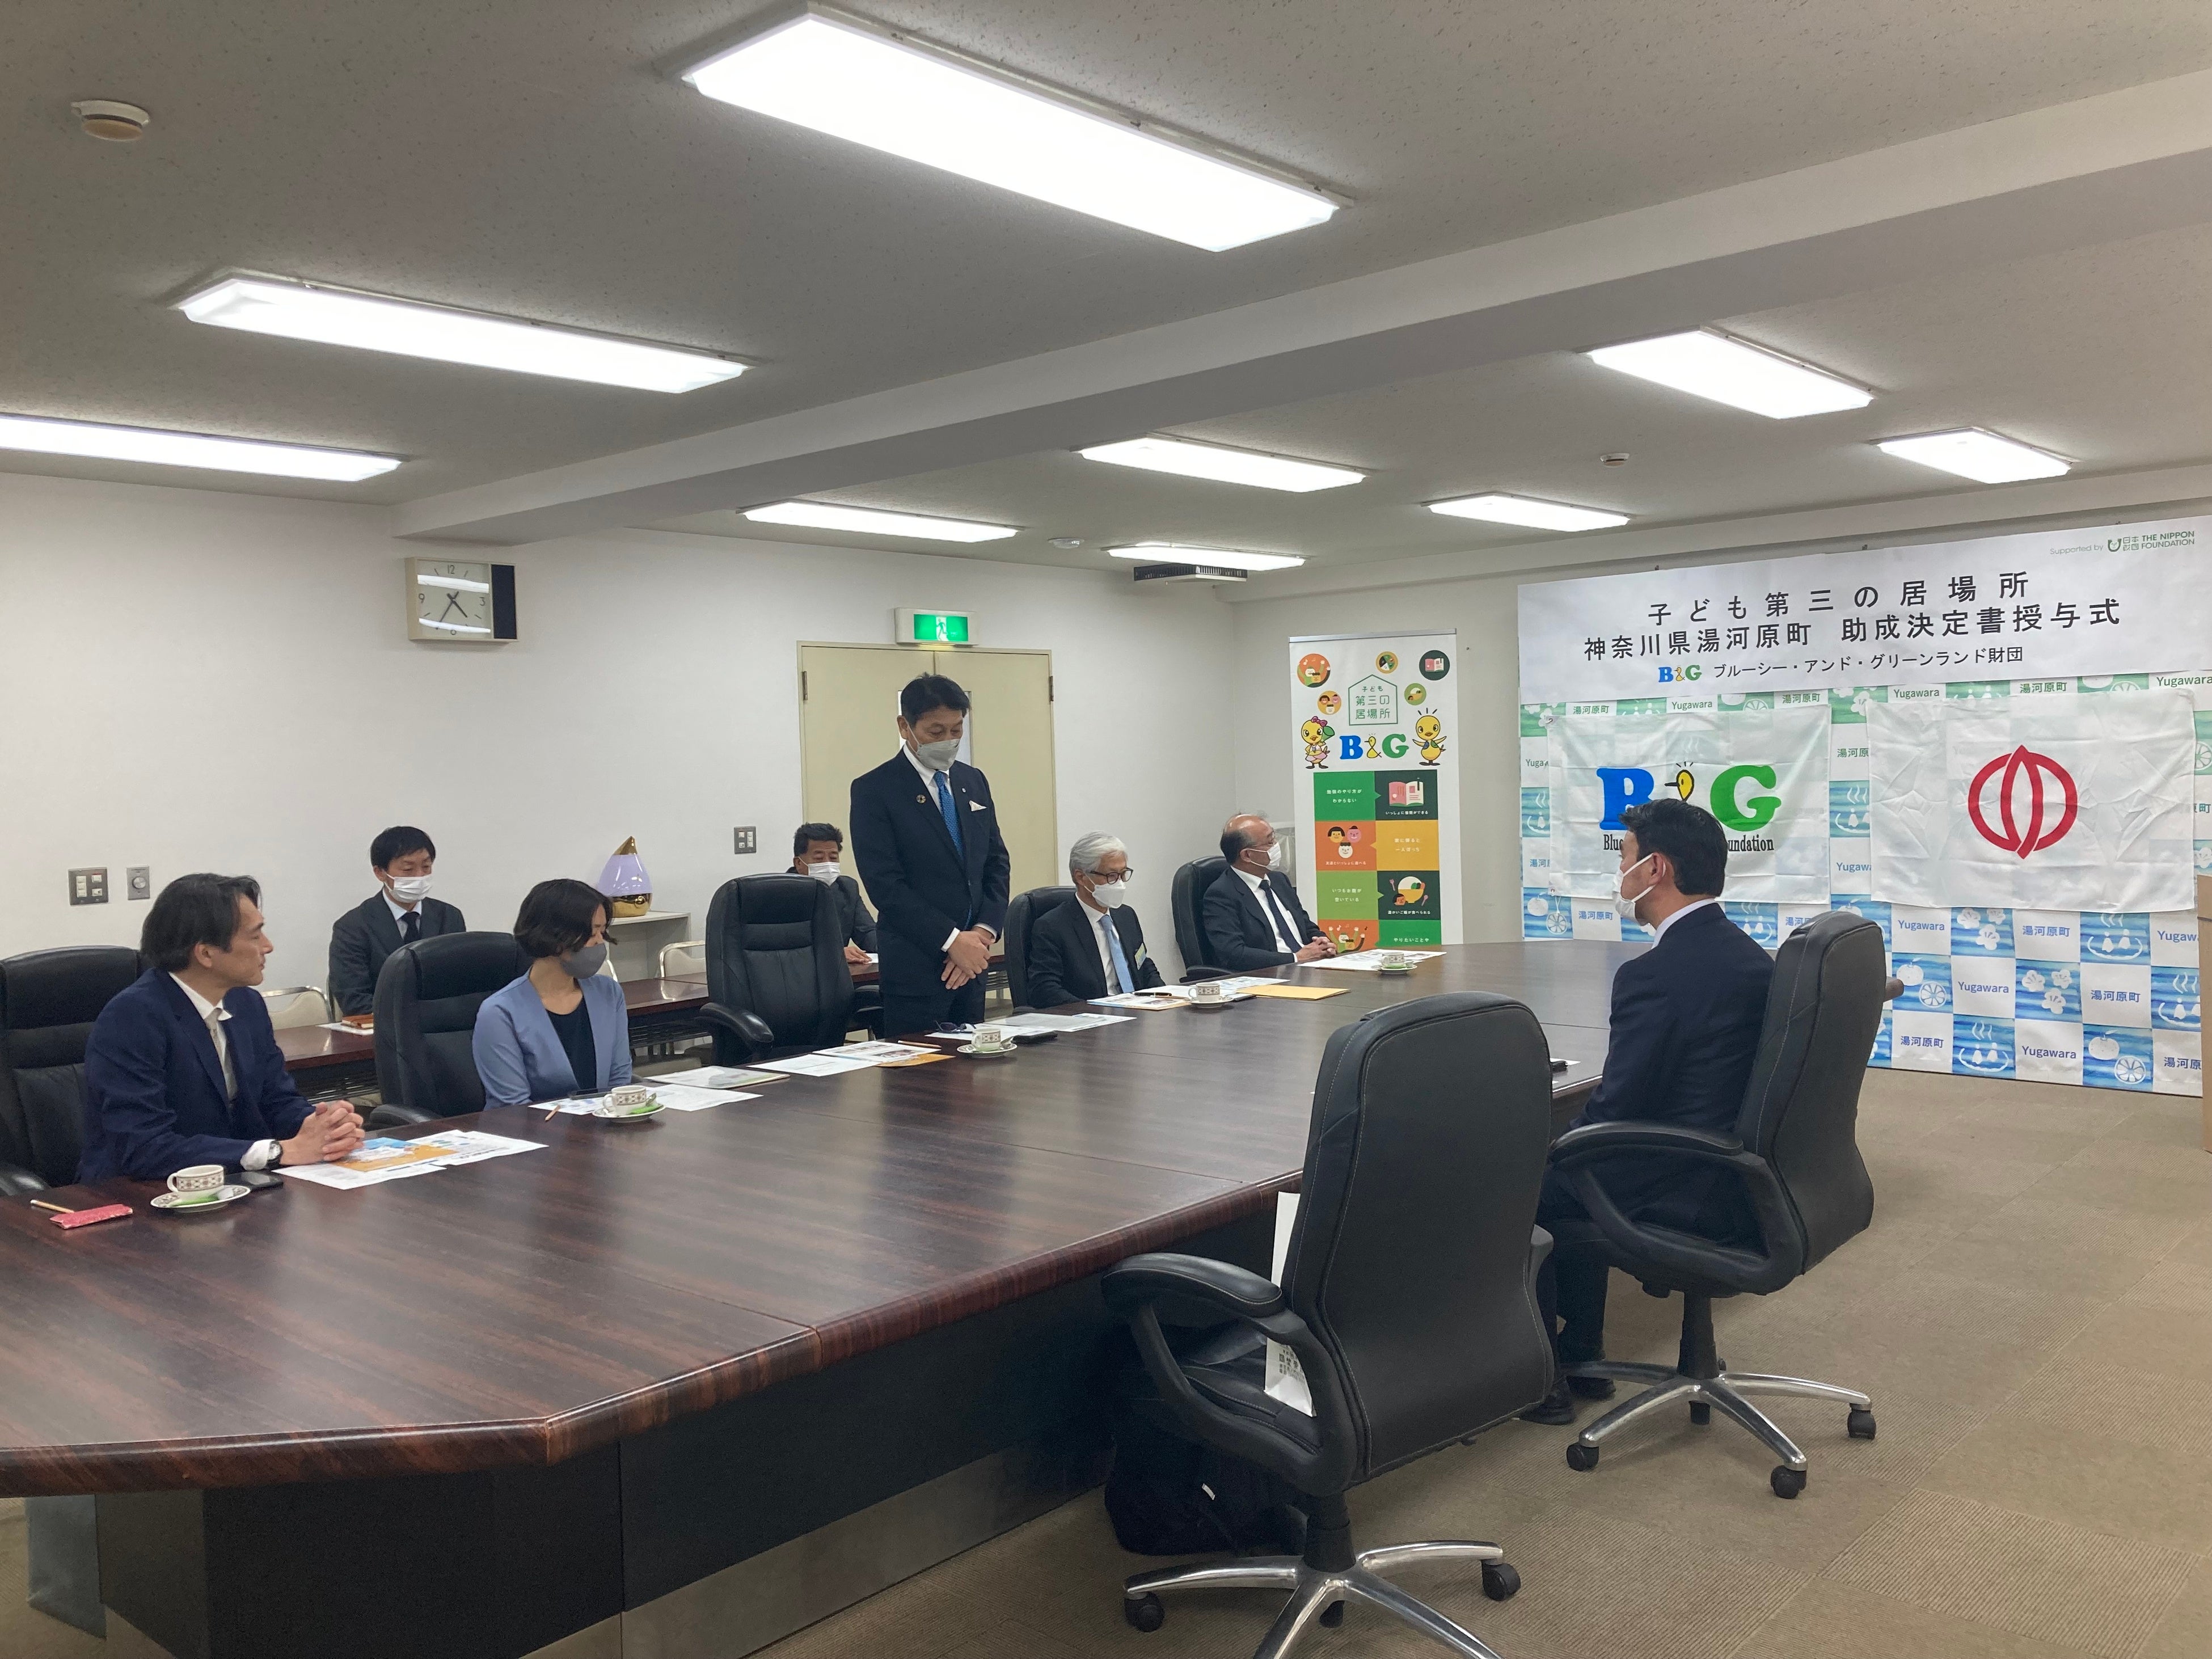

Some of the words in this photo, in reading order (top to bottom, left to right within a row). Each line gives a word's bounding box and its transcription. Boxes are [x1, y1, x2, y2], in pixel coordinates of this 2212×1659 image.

[2160, 530, 2195, 540] NIPPON
[2050, 544, 2092, 555] Supported
[2141, 539, 2195, 549] FOUNDATION
[448, 565, 455, 575] 12
[419, 593, 425, 603] 9
[480, 597, 486, 606] 3
[1648, 571, 2029, 626] 子ども第三の居場所
[1584, 623, 1812, 661] 神奈川県湯河原町
[1841, 598, 2120, 643] 助成決定書授与式
[1658, 665, 1703, 683] B&G
[1714, 647, 2023, 678] ブルーシー・アンド・グリーンランド財団
[2020, 682, 2067, 694] 湯河原町
[2156, 676, 2212, 688] Yugawara
[1782, 692, 1821, 704] 湯河原町
[1893, 687, 1940, 700] Yugawara
[1355, 695, 1390, 706] 第三の
[1671, 701, 1712, 711] Yugawara
[1355, 708, 1390, 720] 居場所
[1573, 705, 1610, 715] 湯河原町
[1339, 733, 1409, 760] B&G
[1837, 748, 1869, 758] 湯河原
[1578, 910, 1614, 921] 湯河原町
[1898, 919, 1945, 931] Yugawara
[2022, 925, 2070, 937] 湯河原町
[1957, 981, 2009, 994] Yugawara
[2091, 990, 2141, 1003] 湯河原町
[1901, 1036, 1944, 1048] 湯河原町
[2021, 1045, 2076, 1059] Yugawara
[2163, 1056, 2202, 1070] 湯河原
